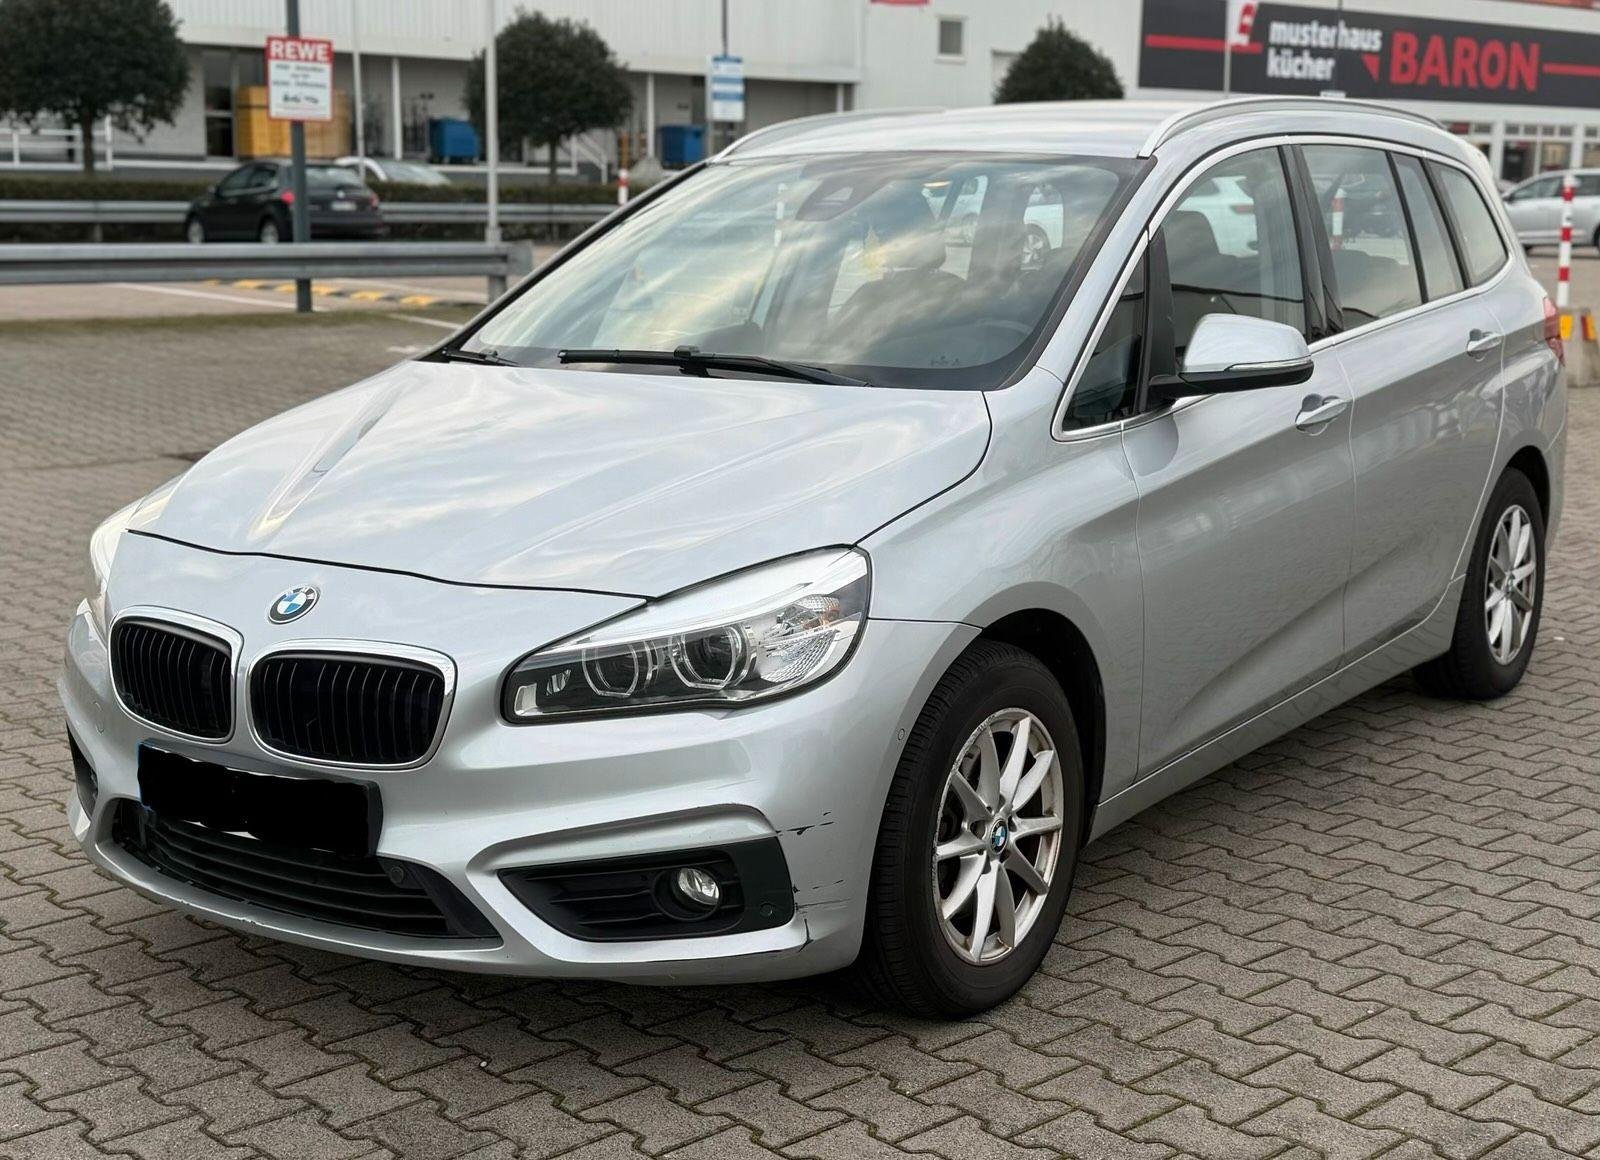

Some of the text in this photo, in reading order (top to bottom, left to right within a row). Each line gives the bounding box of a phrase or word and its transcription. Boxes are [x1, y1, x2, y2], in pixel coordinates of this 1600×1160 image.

[269, 39, 329, 62] REWE
[1269, 20, 1383, 51] musterhaus
[1390, 31, 1540, 91] BARON
